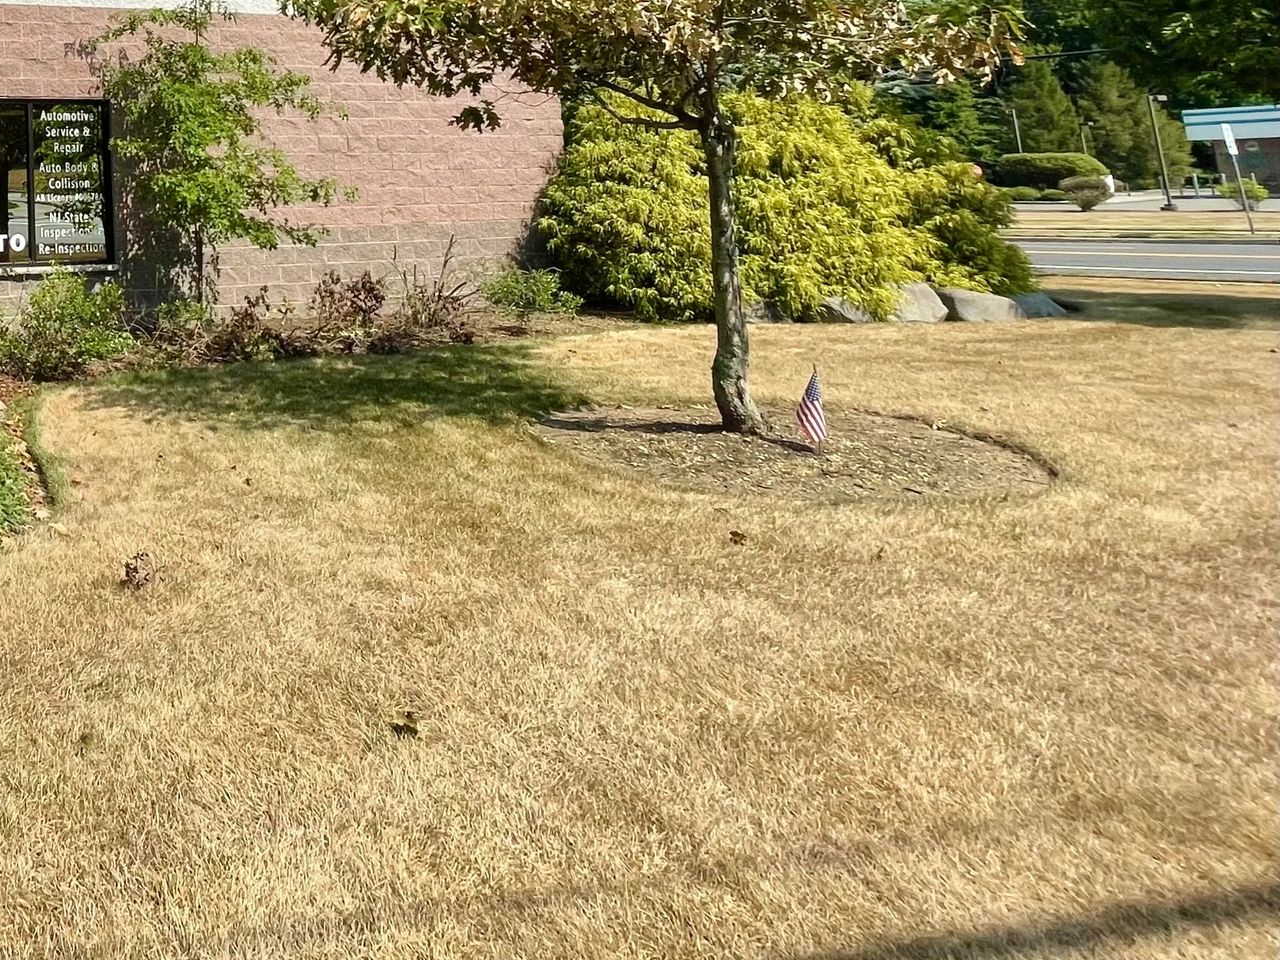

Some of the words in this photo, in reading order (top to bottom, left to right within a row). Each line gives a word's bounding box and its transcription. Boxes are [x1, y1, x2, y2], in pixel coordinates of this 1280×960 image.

[40, 110, 94, 121] Automotive
[45, 126, 80, 137] Service
[82, 126, 90, 136] &
[54, 142, 84, 155] Repair
[39, 162, 61, 173] Auto
[65, 162, 88, 175] Body
[49, 178, 90, 189] Collision
[49, 212, 61, 223] NJ
[64, 212, 89, 223] State
[38, 242, 104, 256] Re-Inspection
